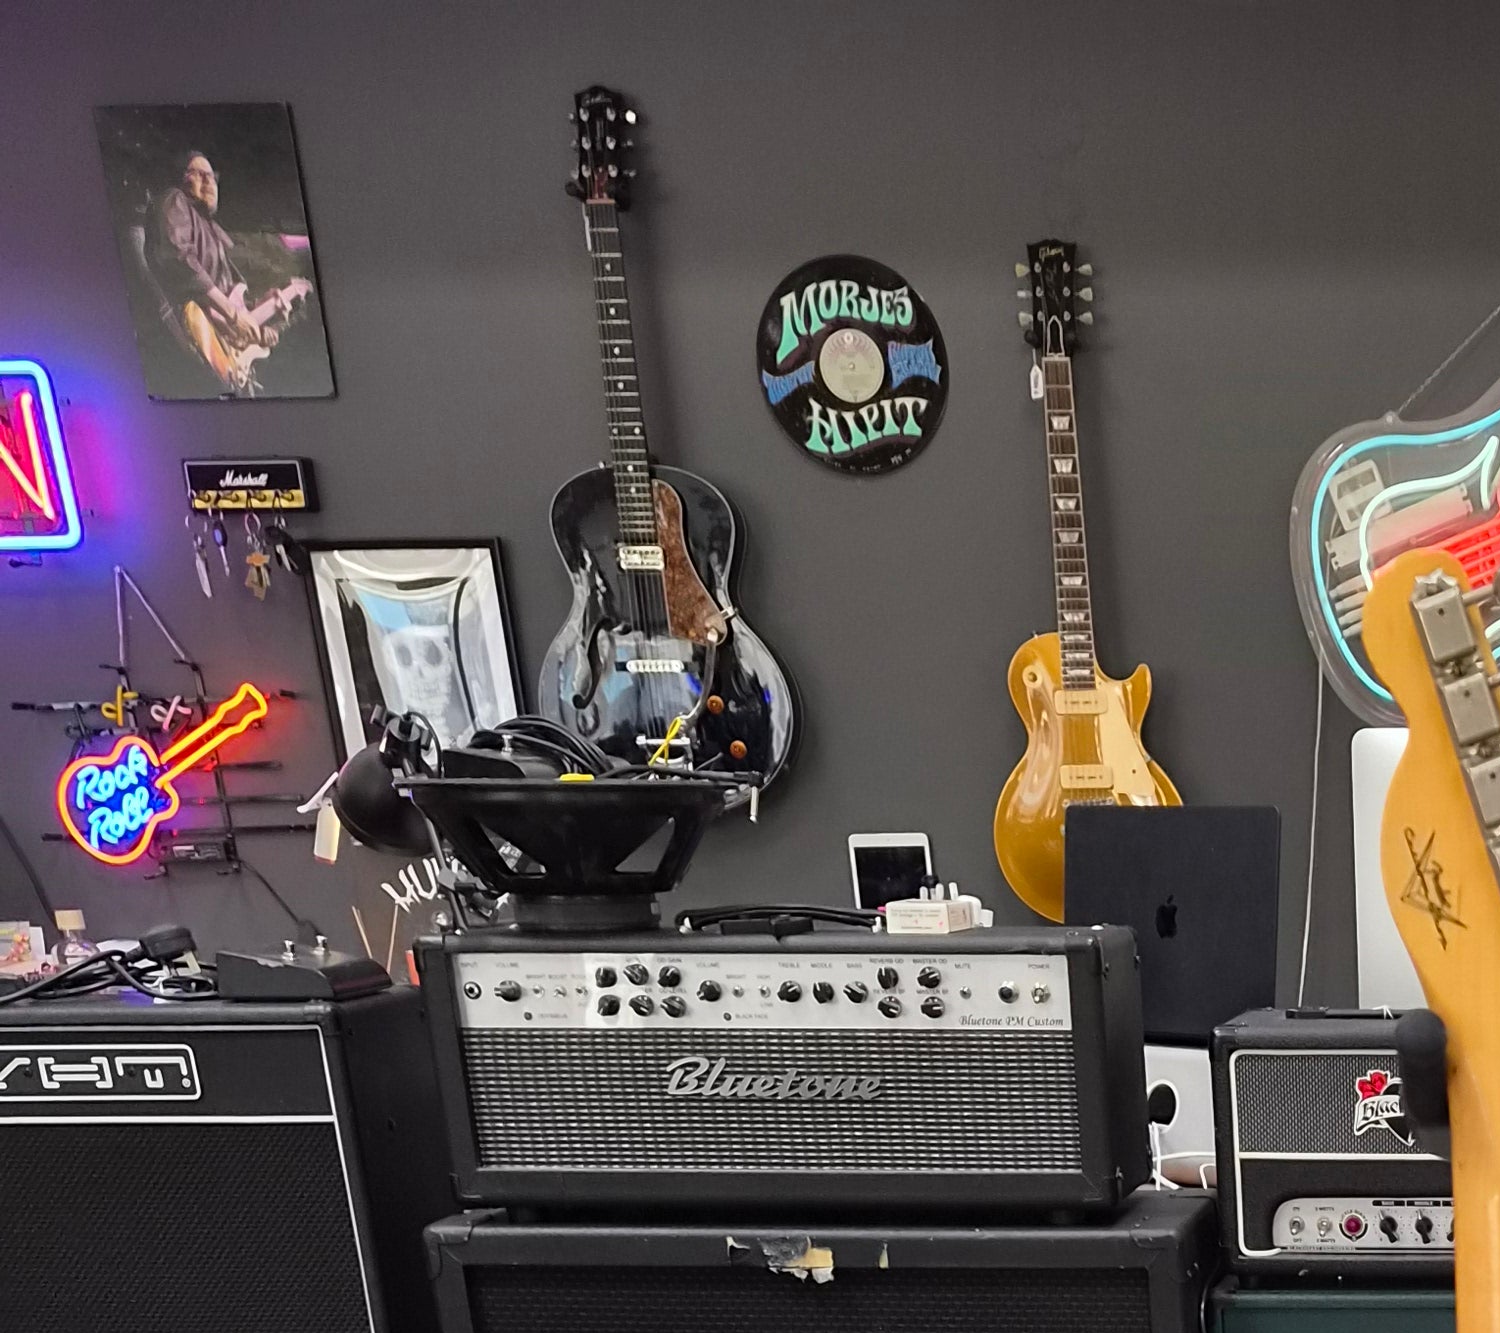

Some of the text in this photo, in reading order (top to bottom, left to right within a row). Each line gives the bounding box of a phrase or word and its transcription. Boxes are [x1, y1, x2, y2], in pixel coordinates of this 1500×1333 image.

[776, 279, 913, 365] MORJES
[219, 469, 268, 488] Marshall
[76, 744, 148, 810] Rock
[87, 785, 155, 850] Roll
[960, 1014, 1002, 1027] Bluetone
[1027, 1015, 1064, 1027] Custom
[665, 1056, 882, 1100] Bluetone
[1361, 1100, 1400, 1121] Blac
